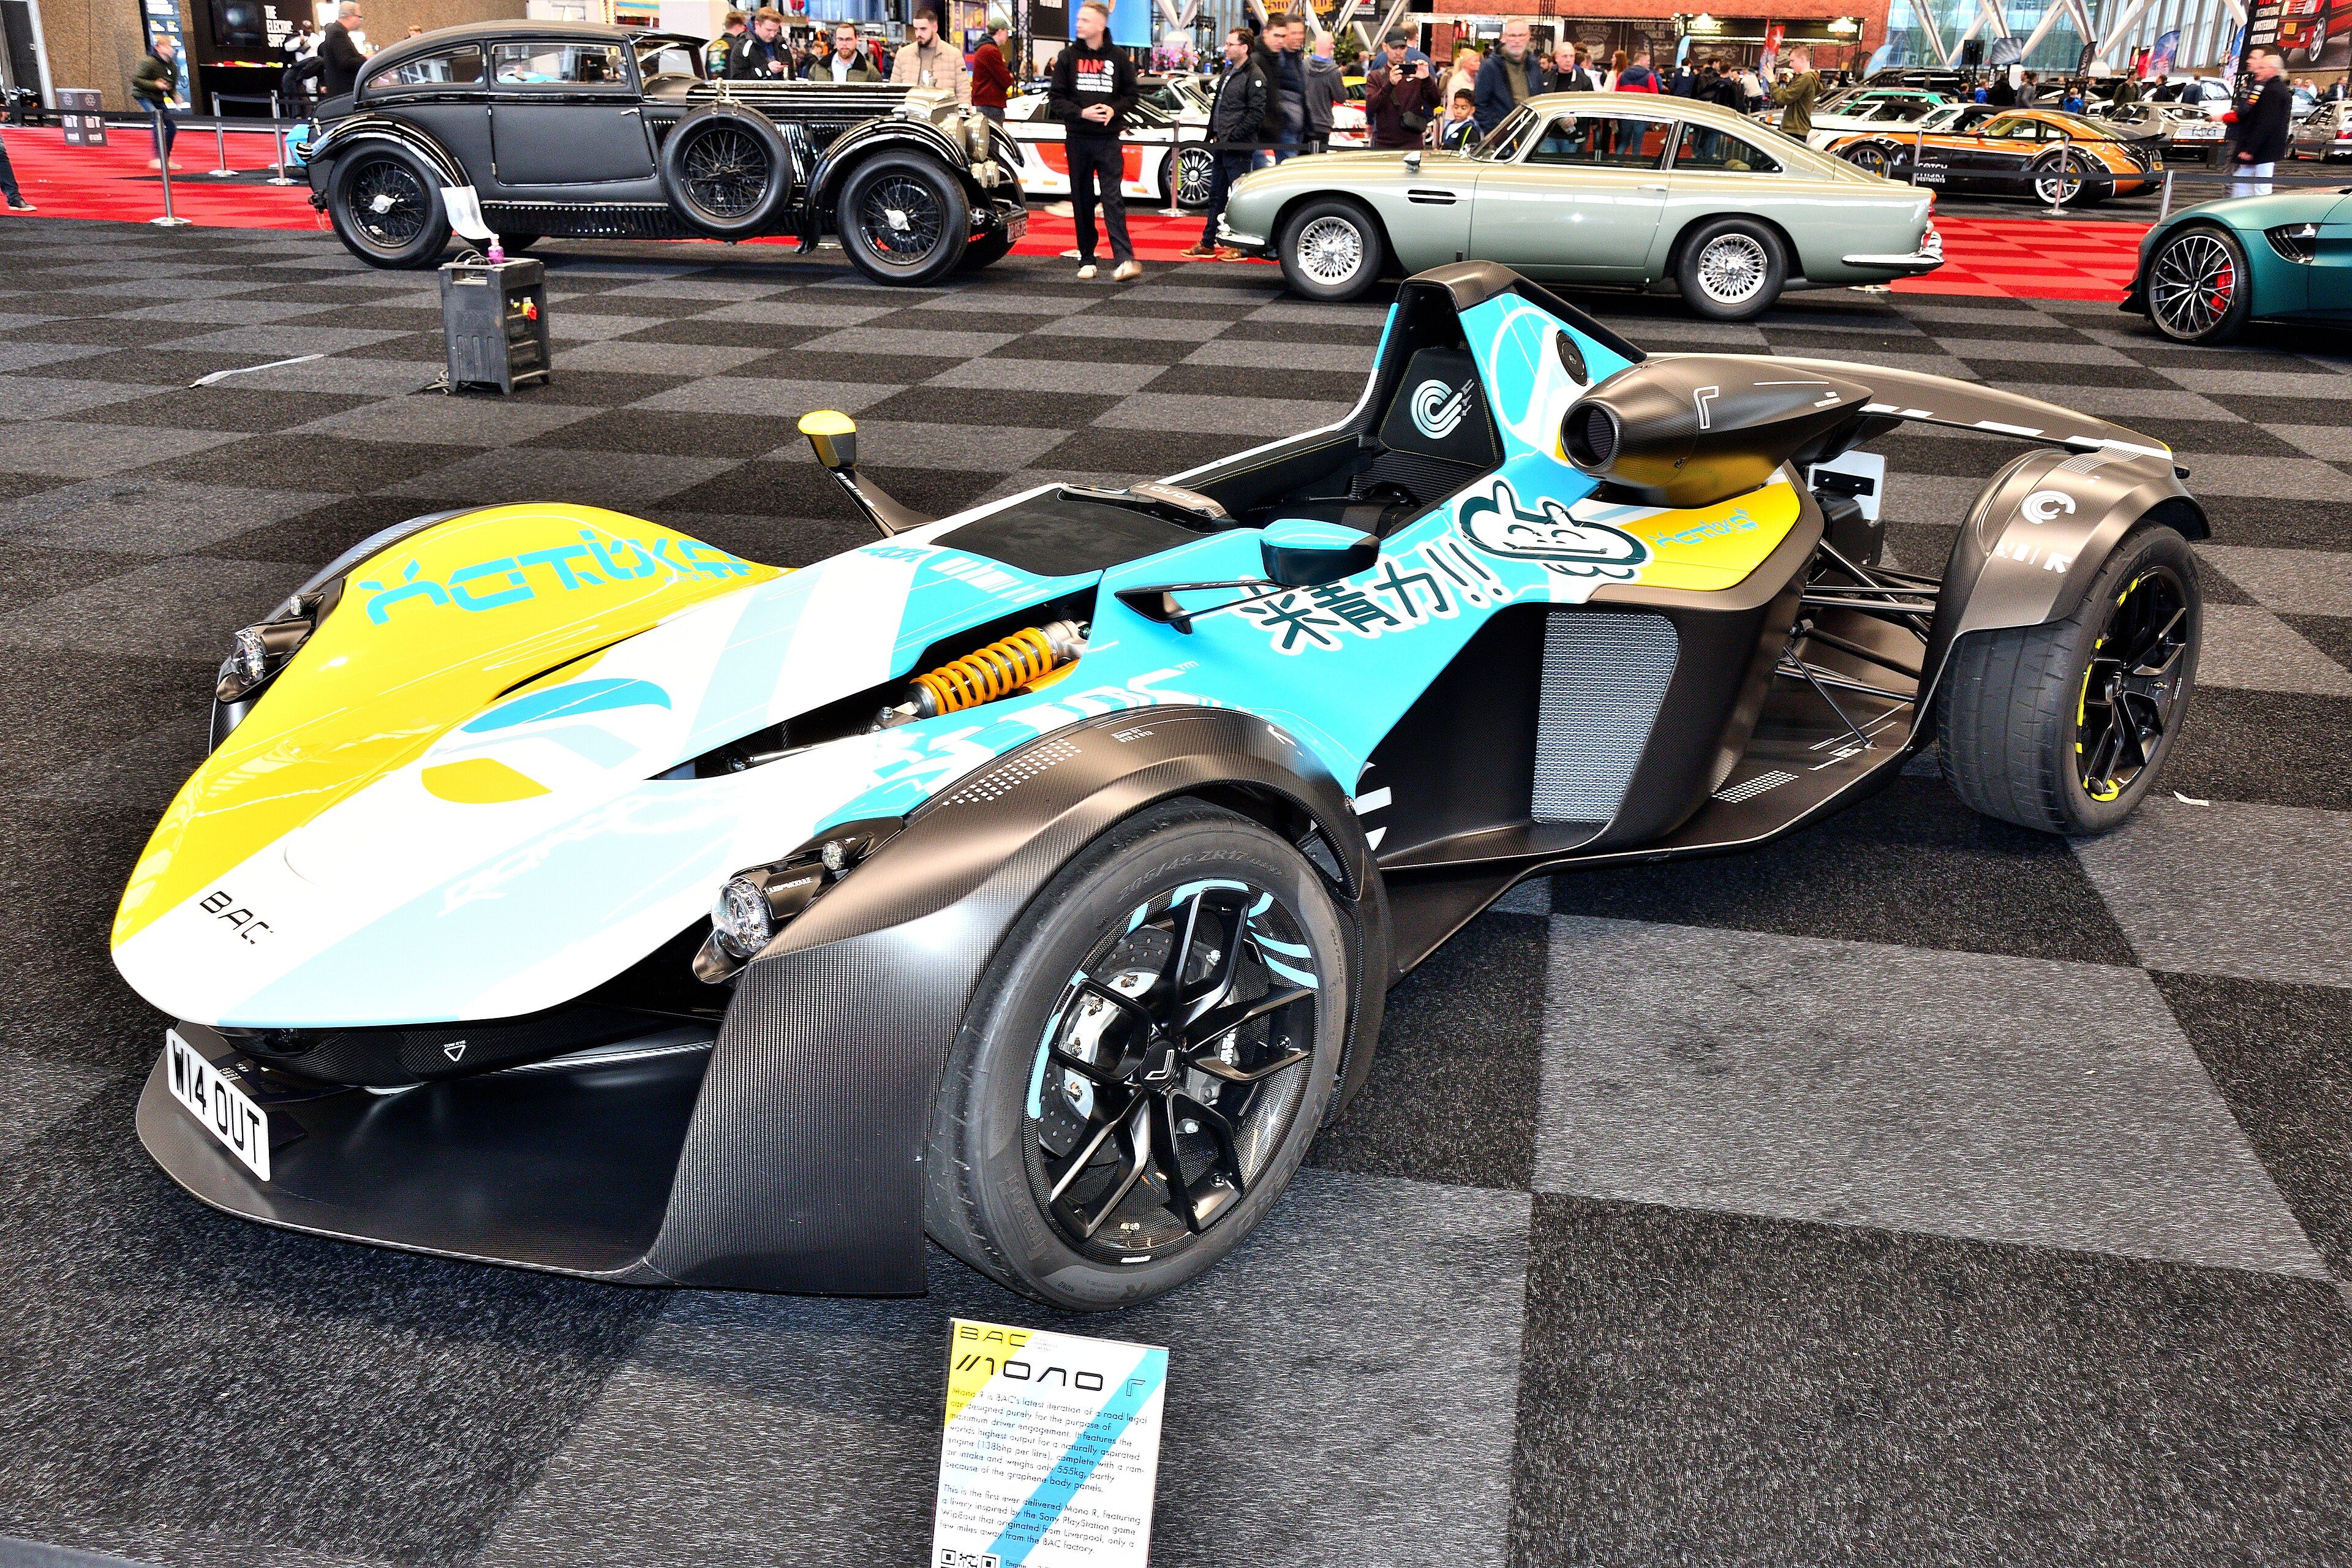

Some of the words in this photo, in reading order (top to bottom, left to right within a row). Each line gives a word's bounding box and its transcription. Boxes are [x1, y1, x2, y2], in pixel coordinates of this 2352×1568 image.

[172, 1039, 206, 1115] W14
[215, 1080, 260, 1164] OUT
[960, 1327, 1027, 1347] BAC
[952, 1387, 976, 1398] Mono
[996, 1393, 1019, 1404] BAC's
[1023, 1398, 1044, 1408] latest
[1047, 1401, 1080, 1414] iteration
[1103, 1412, 1124, 1420] road
[1126, 1413, 1147, 1425] legal
[967, 1402, 1003, 1414] designed
[1006, 1409, 1032, 1420] purely
[1036, 1412, 1047, 1420] for
[1065, 1419, 1099, 1429] purpose
[949, 1413, 987, 1424] maximum
[992, 1419, 1015, 1428] driver
[1018, 1423, 1071, 1438] engagement.
[1084, 1431, 1116, 1444] features
[1120, 1438, 1132, 1447] the
[950, 1425, 974, 1434] worlds
[978, 1428, 1007, 1439] highest
[1010, 1435, 1036, 1444] output
[1038, 1438, 1050, 1446] for
[1061, 1443, 1098, 1456] naturally
[1100, 1449, 1140, 1461] aspirated
[947, 1438, 974, 1447] engine
[978, 1440, 1012, 1453] (138bhp
[1015, 1449, 1029, 1457] per
[1032, 1449, 1052, 1461] litre),
[1057, 1454, 1094, 1466] complete
[960, 1450, 984, 1461] intake
[1006, 1458, 1033, 1469] weighs
[1036, 1464, 1054, 1474] only
[1057, 1466, 1087, 1479] 555kg,
[1090, 1472, 1115, 1483] partly
[945, 1459, 978, 1472] because
[992, 1467, 1004, 1476] the
[1008, 1471, 1047, 1483] graphene
[1050, 1476, 1071, 1488] body
[1074, 1482, 1103, 1493] panels.
[943, 1484, 958, 1493] This
[970, 1488, 982, 1498] the
[986, 1490, 1000, 1501] first
[1023, 1498, 1061, 1510] delivered
[1065, 1504, 1088, 1515] Mono
[1092, 1509, 1099, 1518] R,
[1103, 1510, 1140, 1525] featuring
[951, 1498, 972, 1509] livery
[976, 1502, 1008, 1514] inspired
[1011, 1507, 1021, 1518] by
[1023, 1510, 1036, 1519] the
[1039, 1512, 1059, 1524] Sony
[1063, 1516, 1109, 1531] PlayStation
[1112, 1526, 1136, 1536] game
[940, 1520, 954, 1529] few
[957, 1525, 977, 1534] miles
[980, 1529, 1002, 1540] away
[1006, 1531, 1024, 1542] from
[1027, 1535, 1039, 1544] the
[1042, 1537, 1061, 1548] BAC
[1064, 1540, 1095, 1555] factory.
[941, 1508, 976, 1521] WipEout
[979, 1515, 995, 1524] that
[997, 1519, 1040, 1532] originated
[1042, 1525, 1060, 1534] from
[1064, 1529, 1104, 1544] Liverpool,
[1108, 1537, 1126, 1547] only
